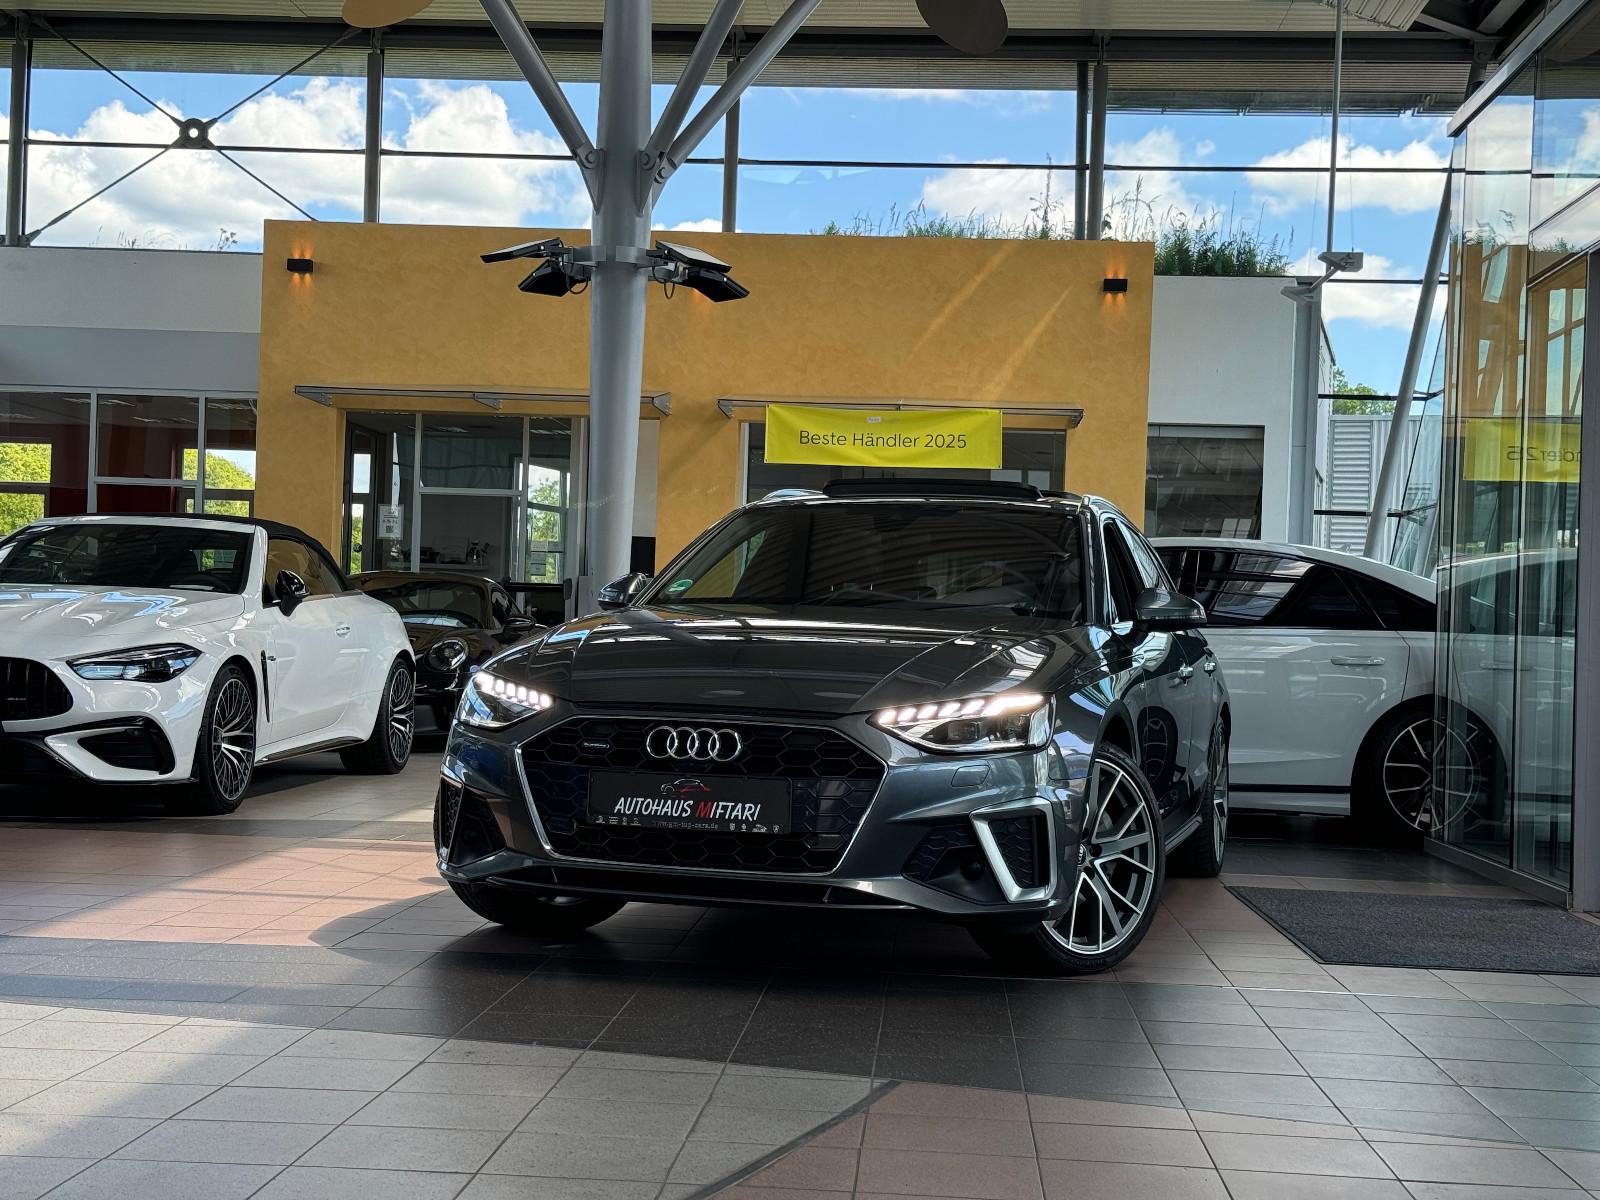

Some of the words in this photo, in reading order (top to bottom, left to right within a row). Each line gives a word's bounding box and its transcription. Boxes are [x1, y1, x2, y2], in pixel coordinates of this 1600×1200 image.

[799, 430, 847, 446] Beste
[853, 432, 920, 449] Händler
[924, 434, 967, 449] 2025
[614, 797, 693, 817] AUTOHAUS
[696, 801, 761, 821] MIFTARI
